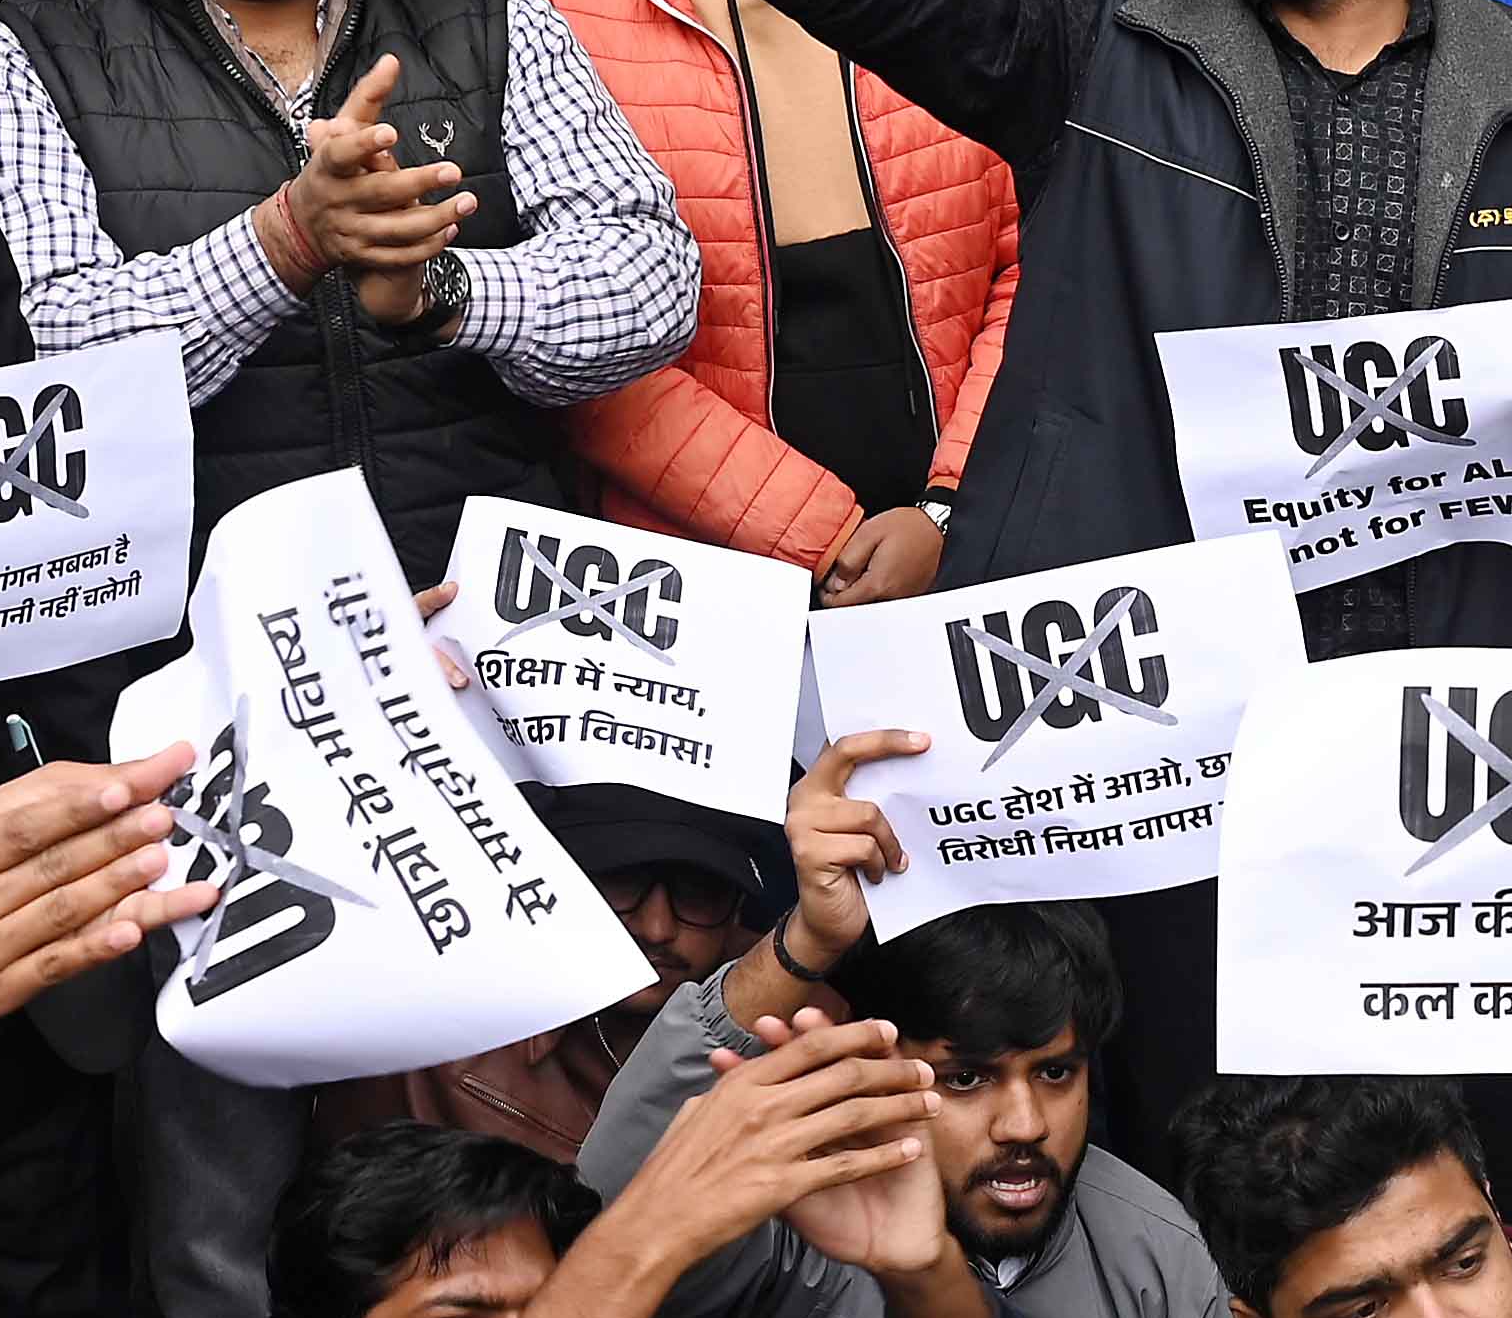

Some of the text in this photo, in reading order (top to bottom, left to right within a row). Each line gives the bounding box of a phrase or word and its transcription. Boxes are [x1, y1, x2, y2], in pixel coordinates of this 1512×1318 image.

[1279, 335, 1469, 455] UGC
[1243, 483, 1375, 528] Equity
[1387, 470, 1447, 495] for
[1288, 525, 1359, 564] not
[1367, 506, 1426, 536] for
[39, 584, 80, 619] नहीं
[82, 571, 143, 610] चलेगी
[494, 527, 682, 651] UGC
[474, 650, 706, 718] शिक्षा में न्याय,
[945, 586, 1169, 742] UGC
[258, 605, 473, 956] छात्रों के भविष्य
[324, 571, 559, 927] से समझौता नहीं!
[929, 757, 1192, 827] UGC होश में आओ,
[1353, 900, 1461, 939] आज
[1360, 982, 1455, 1020] कल
